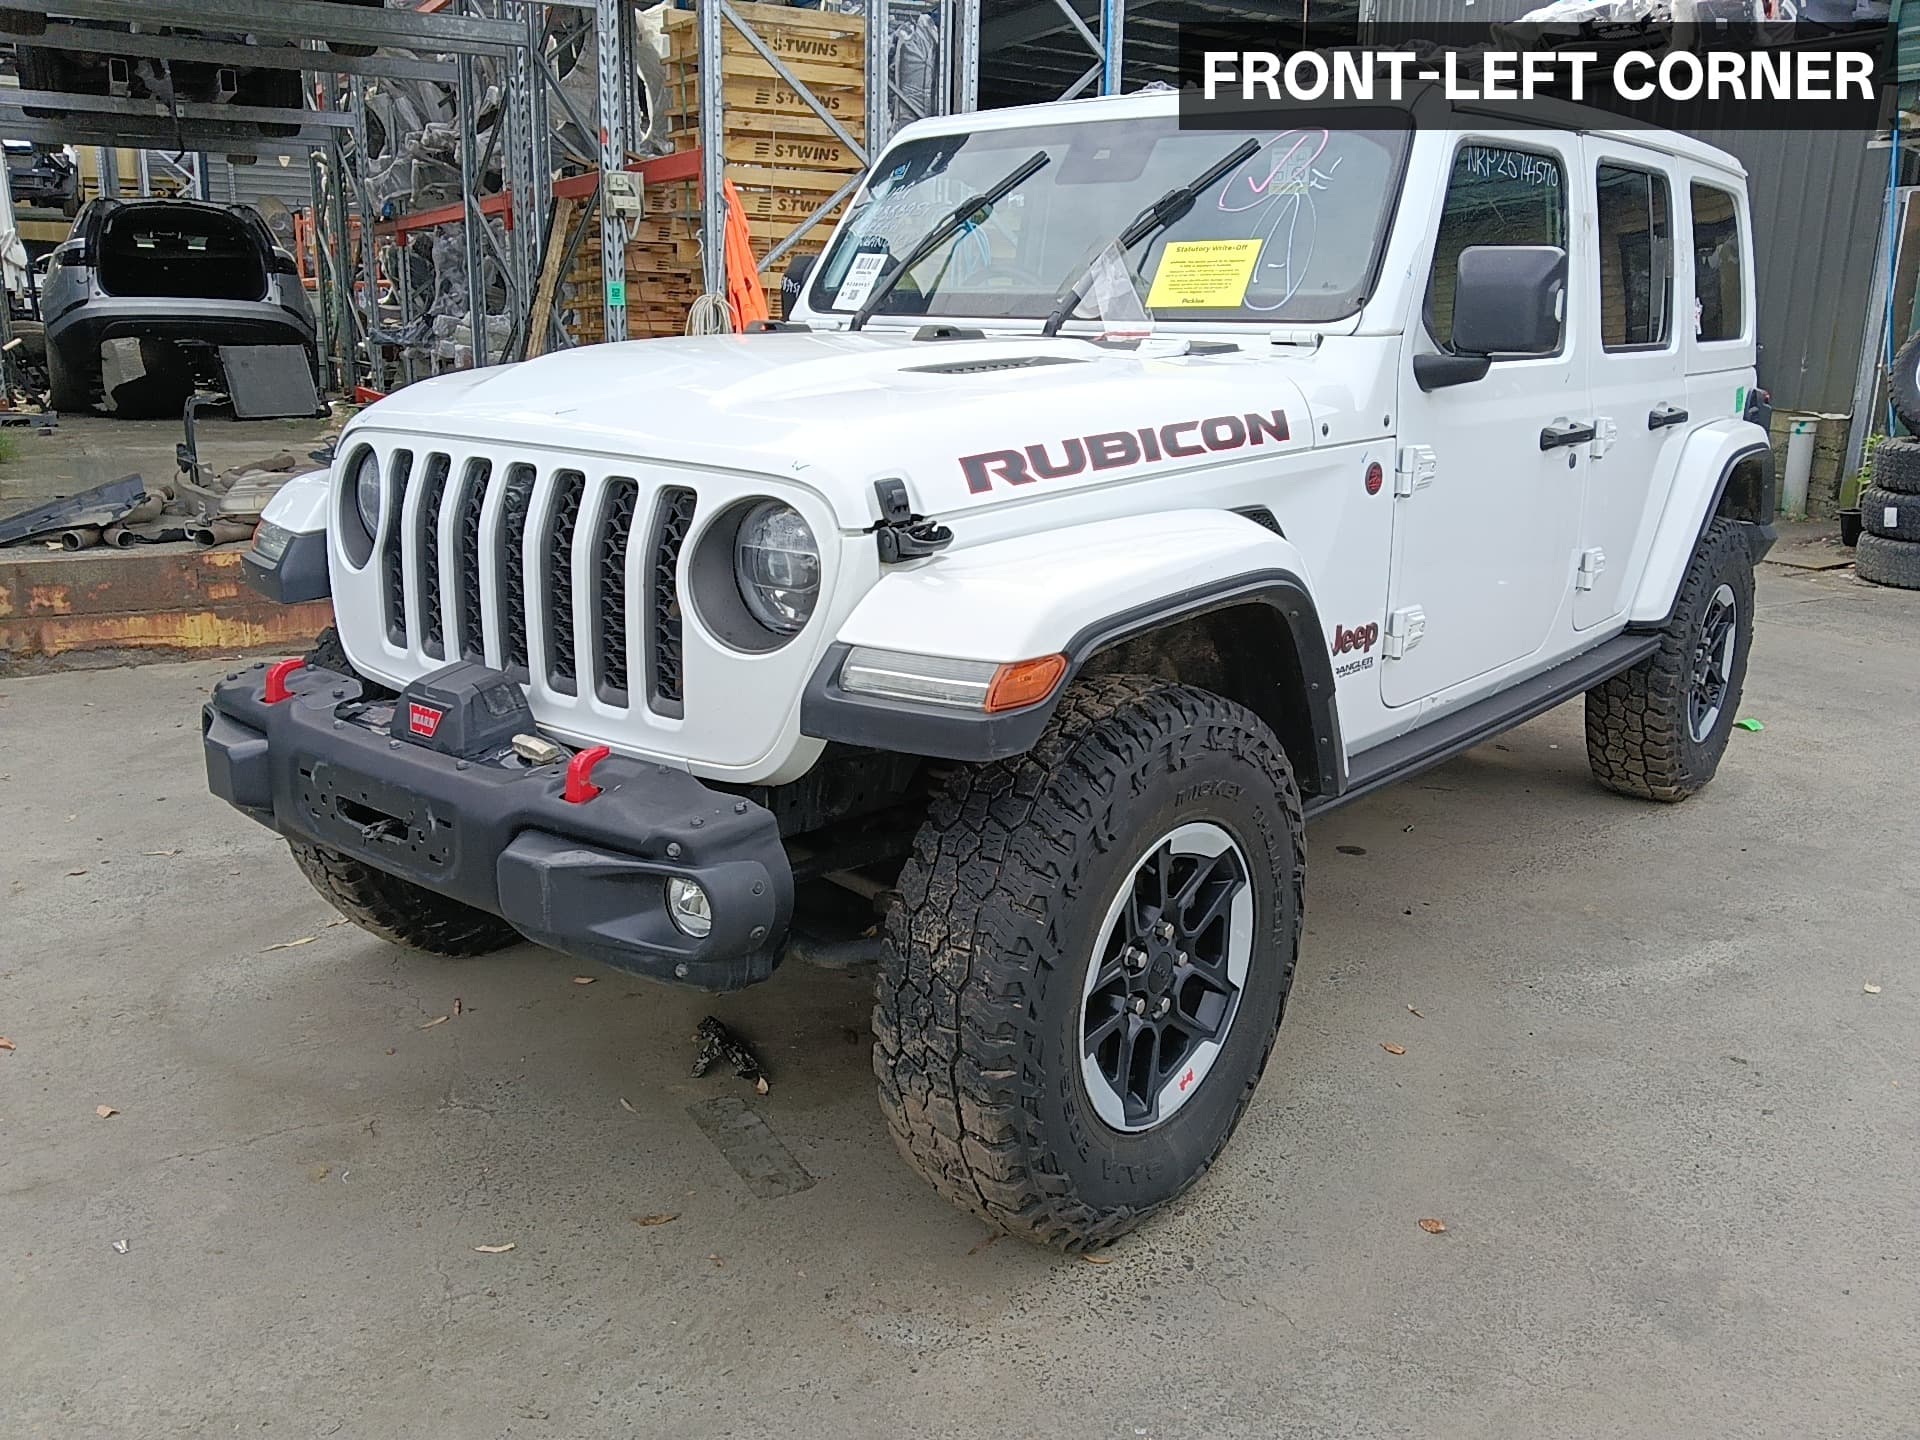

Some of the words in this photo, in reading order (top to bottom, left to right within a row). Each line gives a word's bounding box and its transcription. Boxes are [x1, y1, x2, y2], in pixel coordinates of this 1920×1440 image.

[1212, 244, 1249, 252] Write-Off
[958, 409, 1291, 495] RUBICON
[1332, 621, 1379, 657] Jeep
